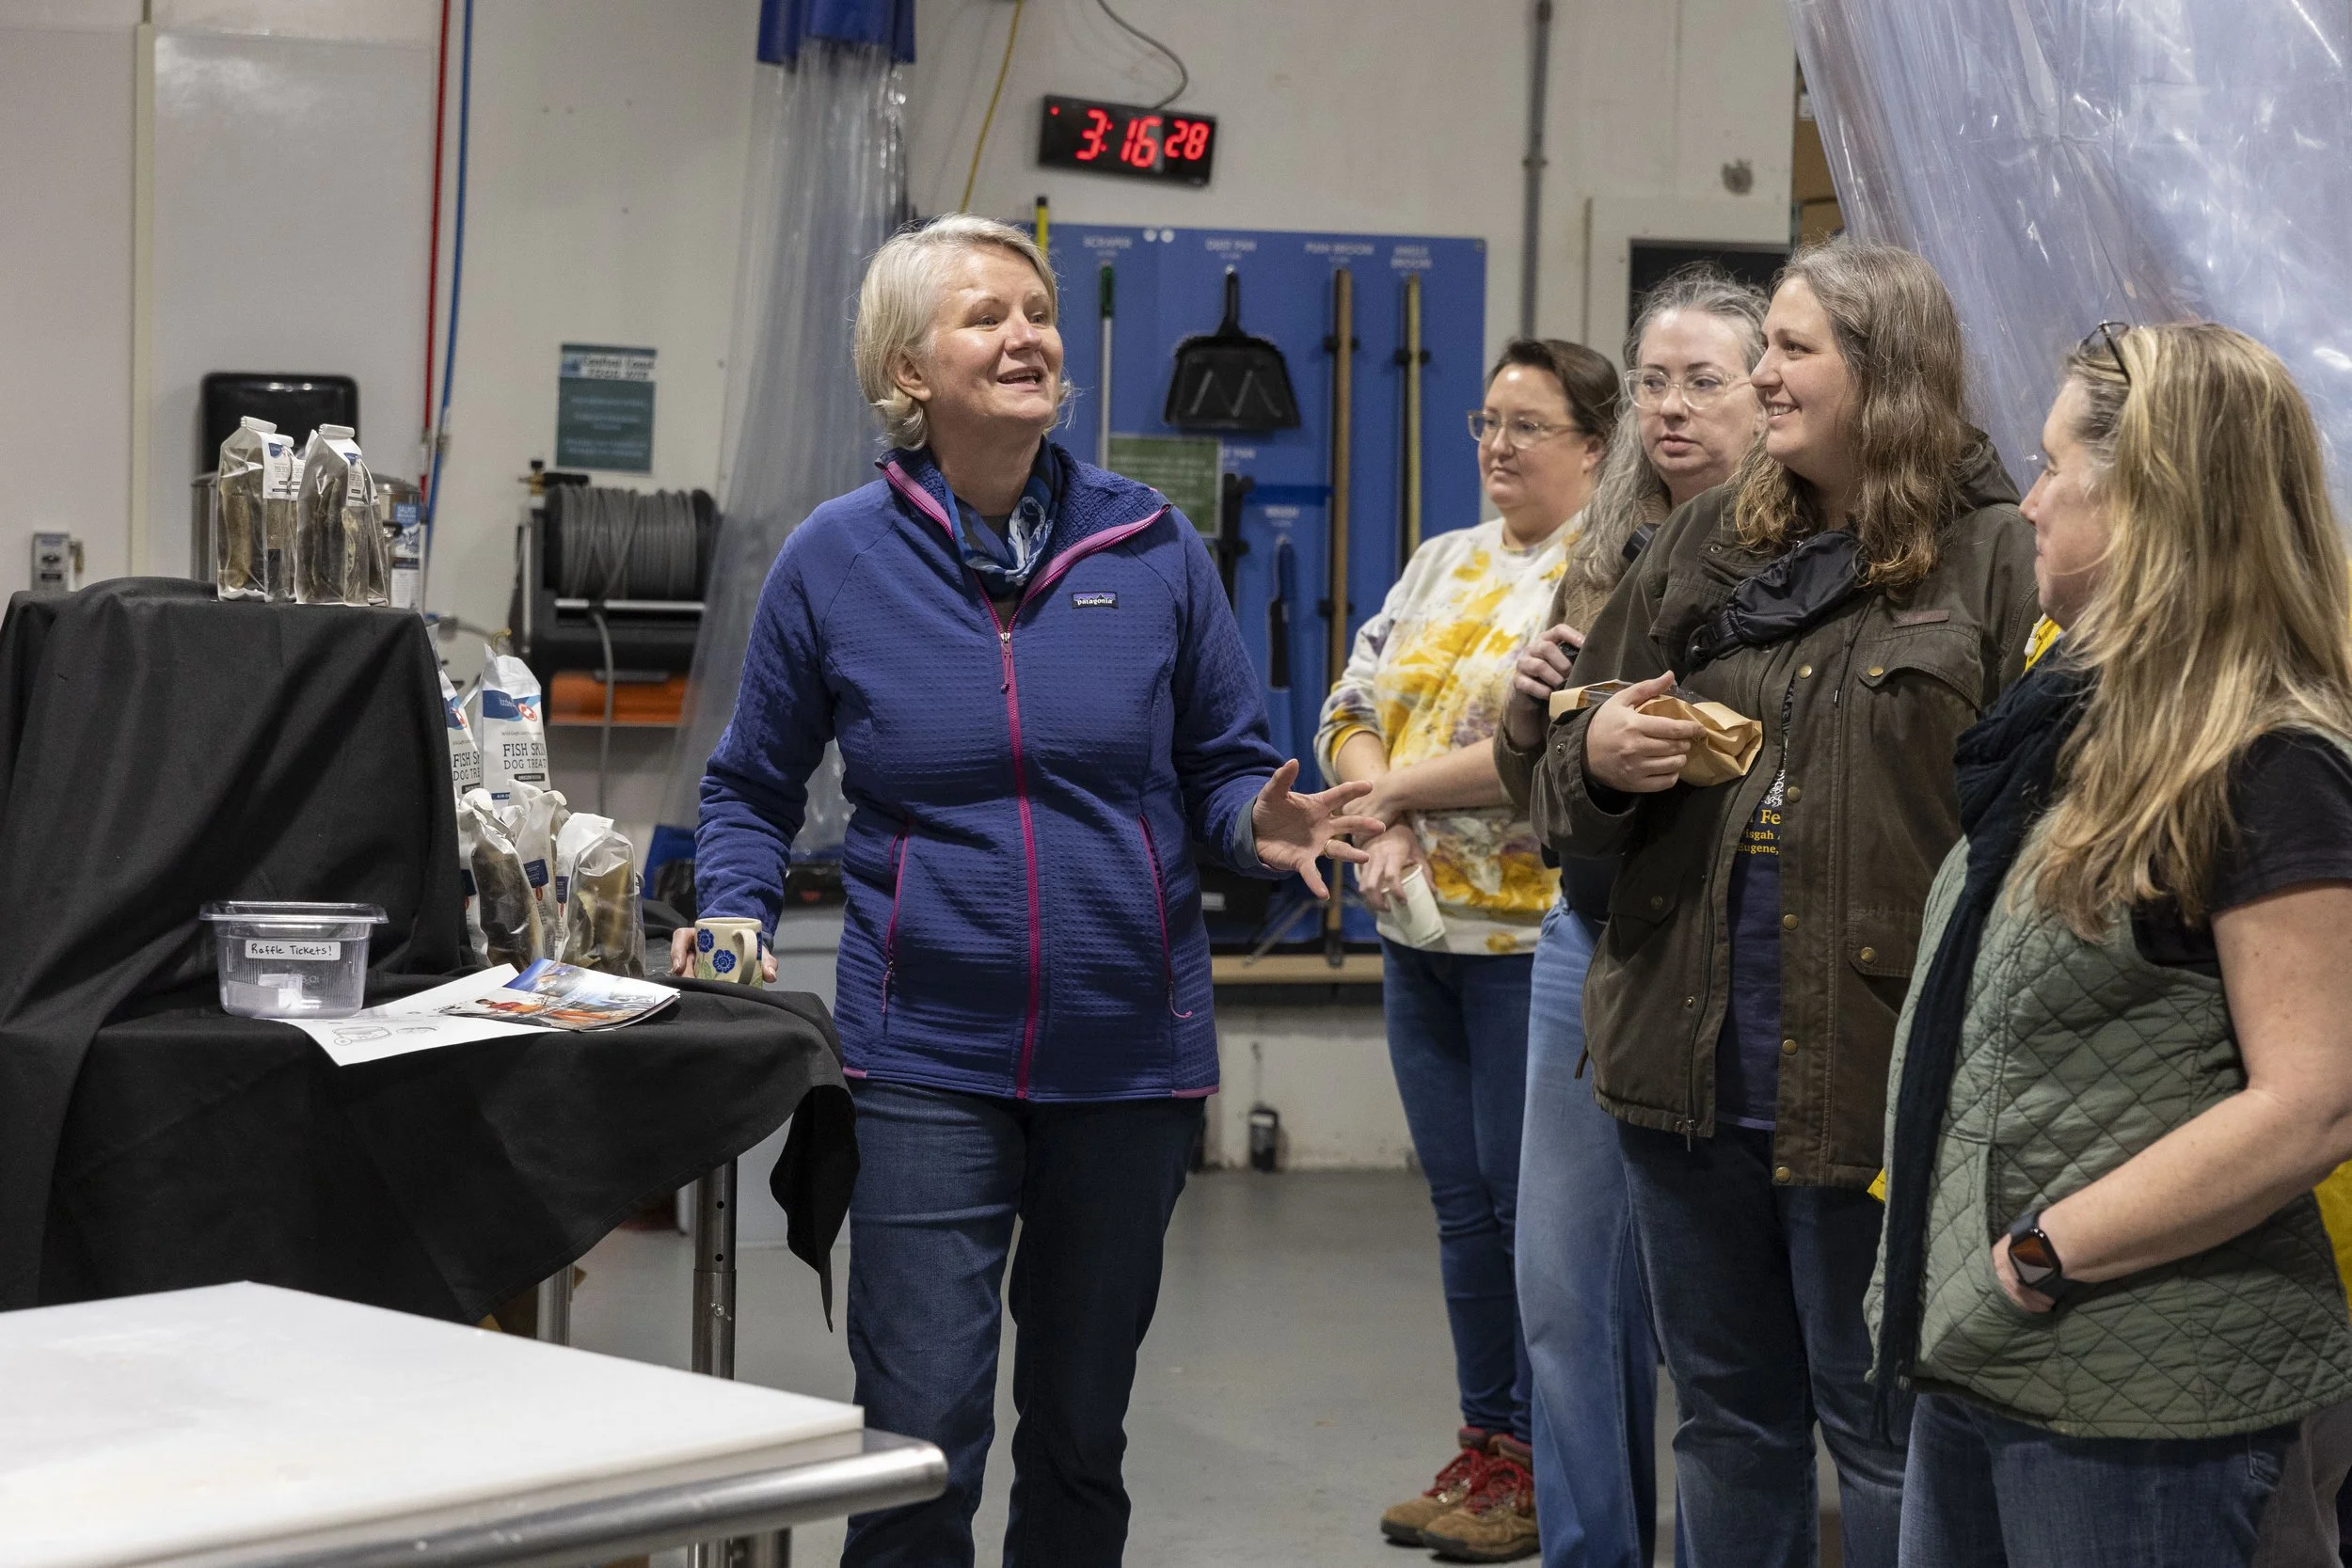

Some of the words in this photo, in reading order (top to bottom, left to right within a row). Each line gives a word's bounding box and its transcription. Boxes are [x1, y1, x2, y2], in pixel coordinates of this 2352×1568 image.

[1074, 108, 1163, 168] 3:16
[1164, 119, 1210, 161] 28
[502, 743, 528, 757] FISH
[453, 752, 470, 768] FISH
[504, 759, 524, 769] DOG
[453, 769, 469, 781] DOG
[1745, 829, 1774, 841] isgah
[251, 942, 285, 955] Raffle
[289, 945, 332, 956] Tickets!
